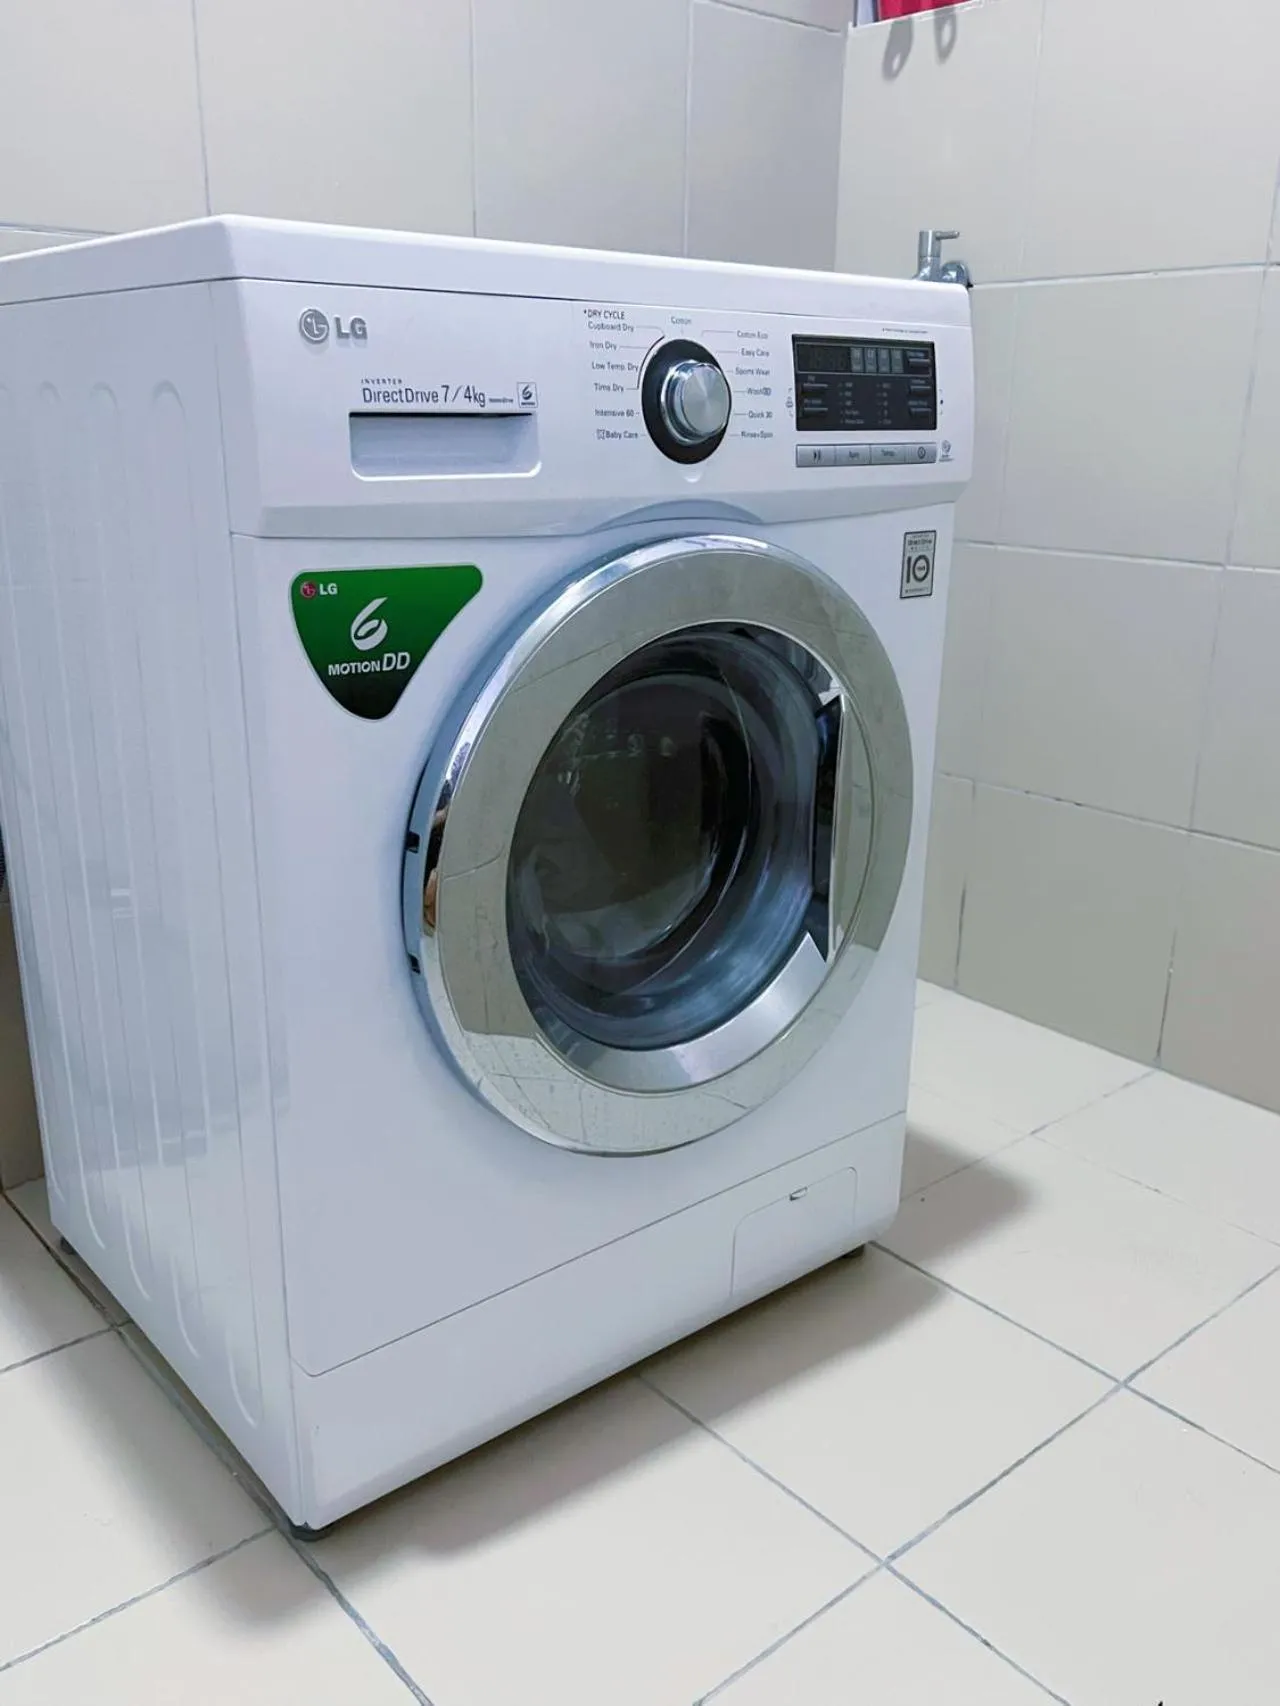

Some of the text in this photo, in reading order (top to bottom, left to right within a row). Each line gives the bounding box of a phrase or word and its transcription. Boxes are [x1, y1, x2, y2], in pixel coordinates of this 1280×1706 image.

[604, 310, 625, 320] CYCLE
[334, 316, 368, 340] LG
[622, 323, 634, 332] Dry
[605, 341, 617, 350] Dry
[627, 363, 639, 372] Dry
[612, 384, 624, 393] Dry
[594, 409, 634, 417] Intensive 60
[605, 431, 638, 440] Baby Care
[319, 583, 338, 595] LG
[351, 597, 389, 651] 6
[328, 652, 410, 676] MOTION DD
